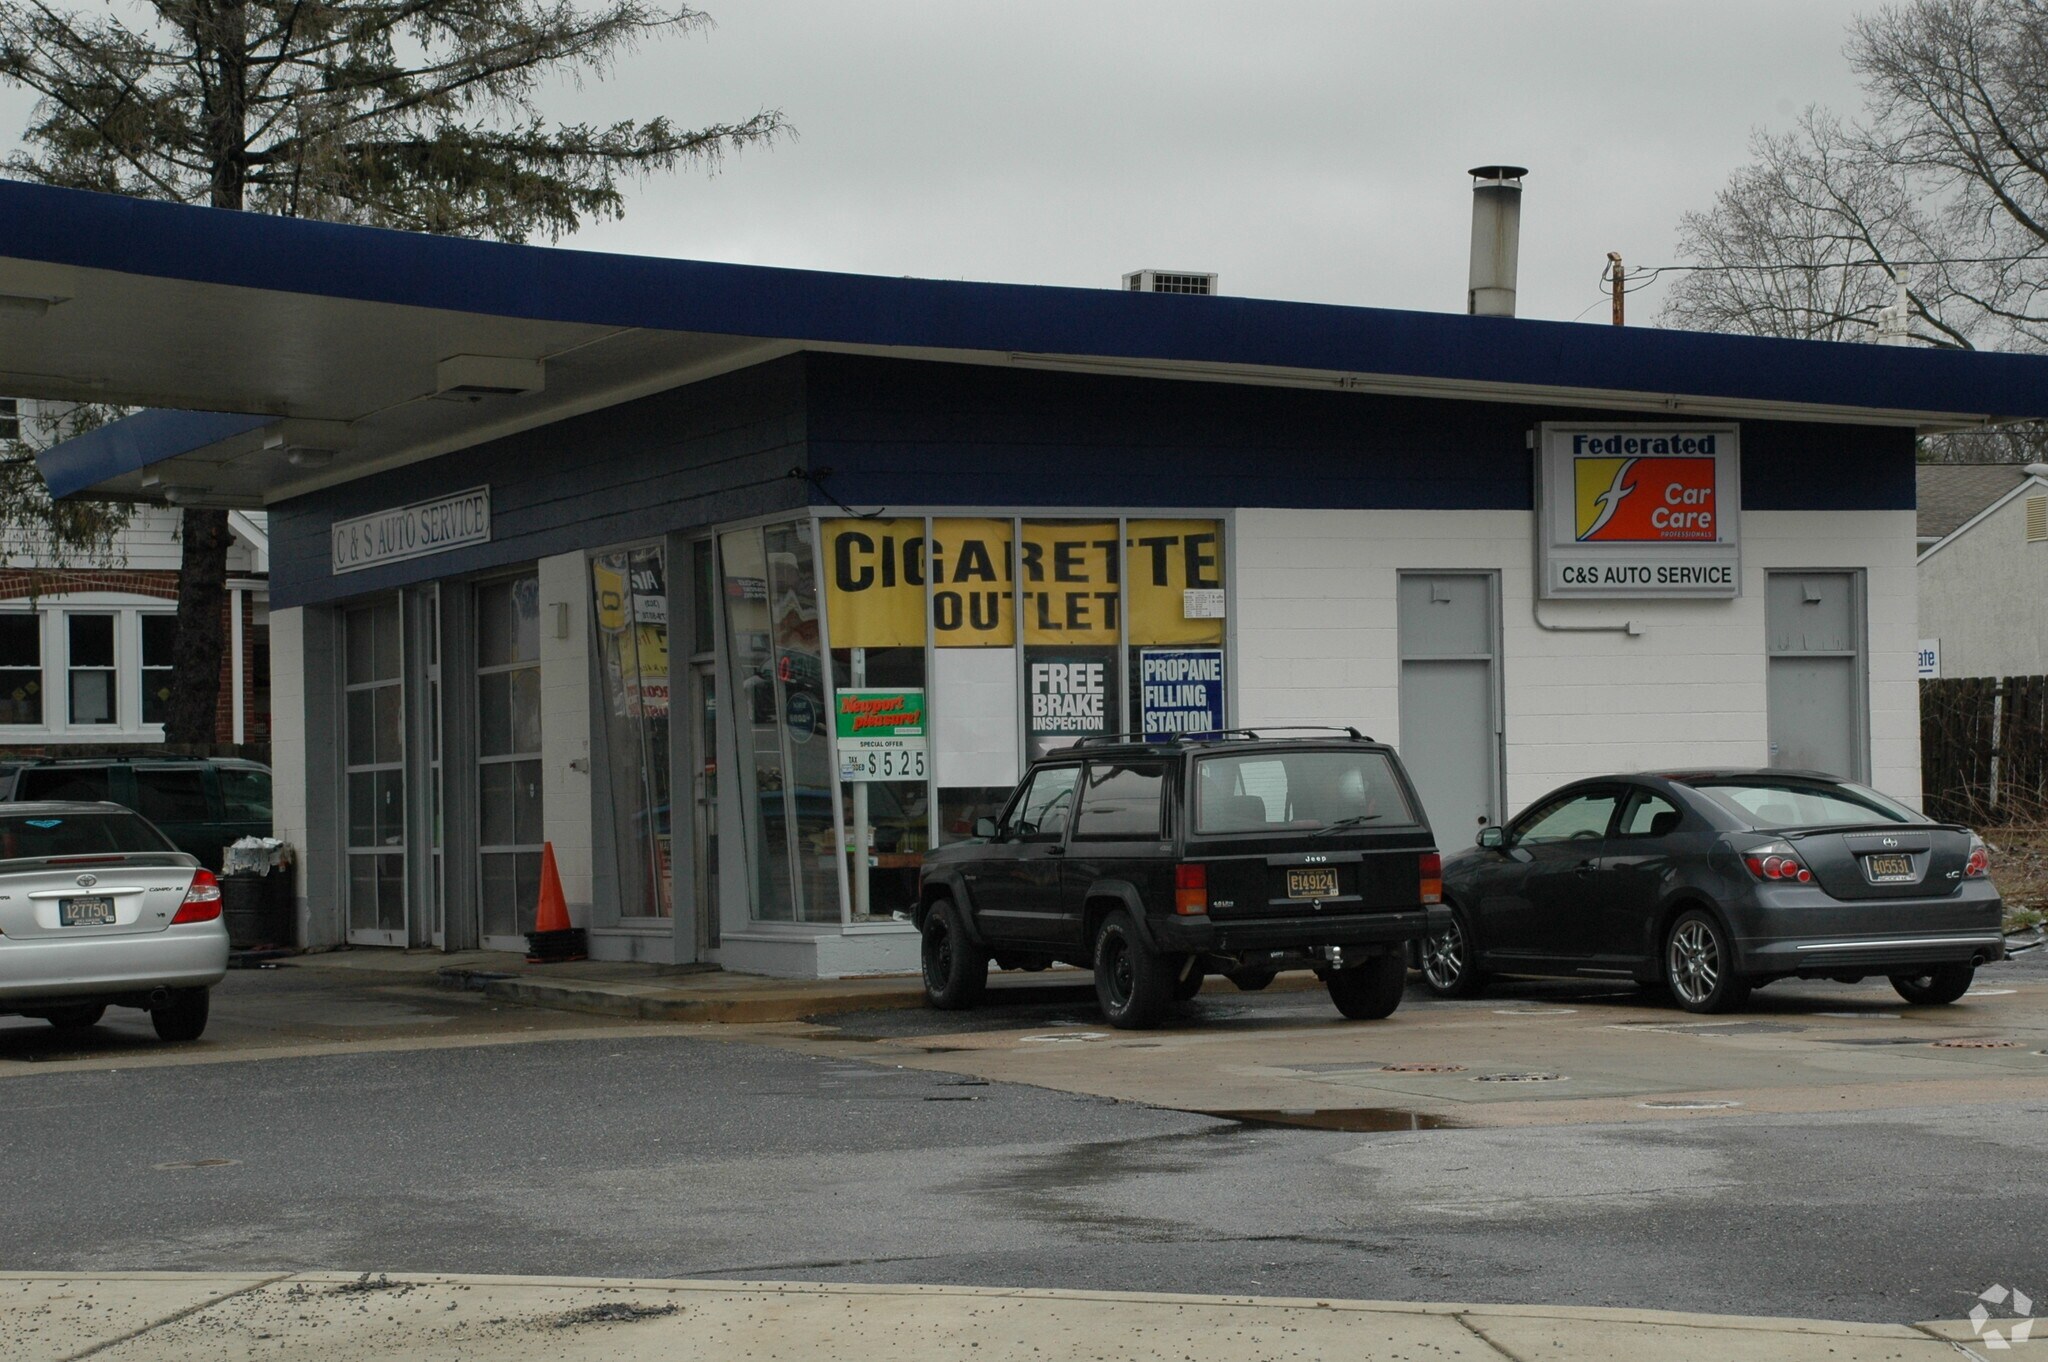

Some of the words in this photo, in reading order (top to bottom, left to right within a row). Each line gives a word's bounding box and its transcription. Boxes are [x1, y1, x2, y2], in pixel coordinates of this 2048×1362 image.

[1573, 434, 1716, 454] Federated
[1664, 483, 1712, 505] Car
[1651, 507, 1712, 528] Care
[337, 530, 346, 564] C
[350, 526, 359, 561] &
[363, 523, 373, 557] S
[378, 512, 416, 556] AUTO
[421, 495, 485, 545] SERVICE
[1660, 530, 1712, 538] PROFESSIONALS
[835, 531, 1219, 592] CIGARETTE
[1562, 566, 1599, 583] C&S
[1604, 566, 1652, 583] AUTO
[1657, 566, 1732, 583] SERVICE
[1031, 663, 1104, 695] FREE
[1143, 658, 1221, 682] PROPANE
[841, 695, 904, 715] Newport
[1031, 694, 1104, 717] BRAKE
[1145, 684, 1207, 708] FILLING
[852, 710, 921, 731] pleasure!
[1032, 716, 1104, 731] INSPECTION
[1145, 710, 1212, 732] STATION
[1305, 855, 1327, 863] Jeep
[1873, 859, 1909, 875] 405531
[66, 903, 109, 919] 127750
